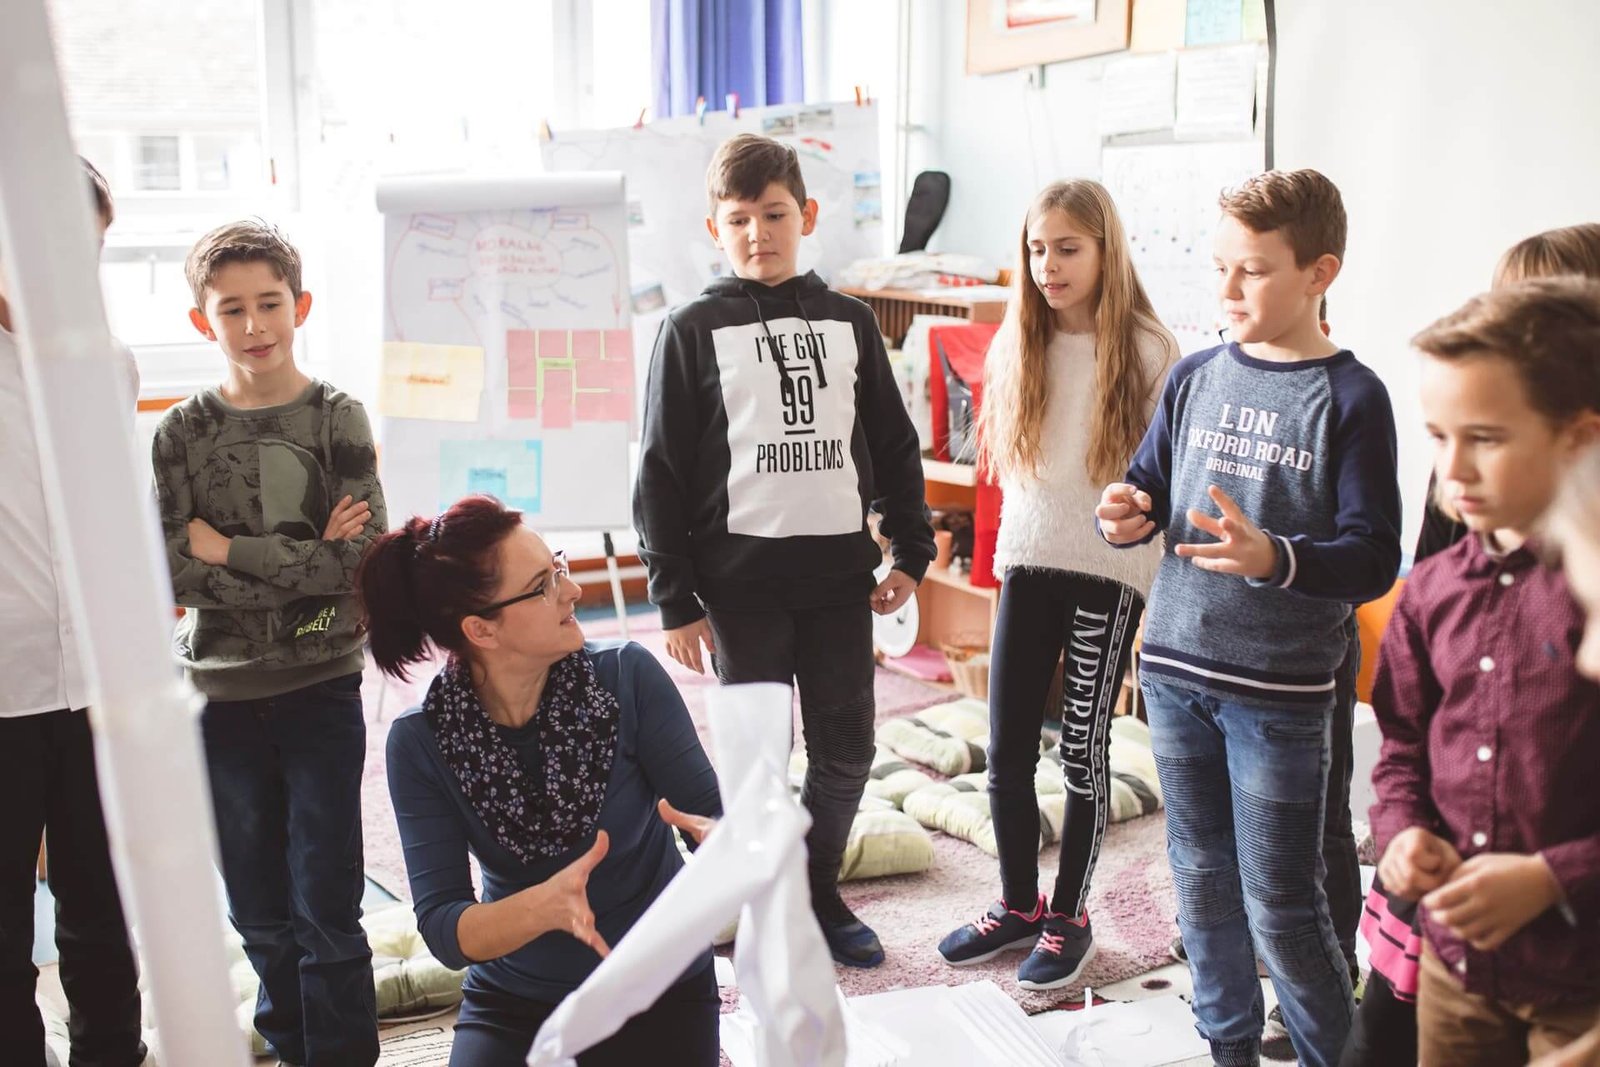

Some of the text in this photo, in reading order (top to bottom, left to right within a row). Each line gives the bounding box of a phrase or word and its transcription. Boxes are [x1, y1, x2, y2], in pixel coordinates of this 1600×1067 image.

[793, 332, 827, 360] GOT
[780, 375, 815, 426] 99
[1219, 403, 1279, 437] LDN
[756, 439, 844, 474] PROBLEMS
[1205, 456, 1265, 481] ORIGINAL
[1254, 440, 1313, 472] ROAD
[329, 606, 336, 618] A
[1060, 604, 1109, 801] IMPERFECT
